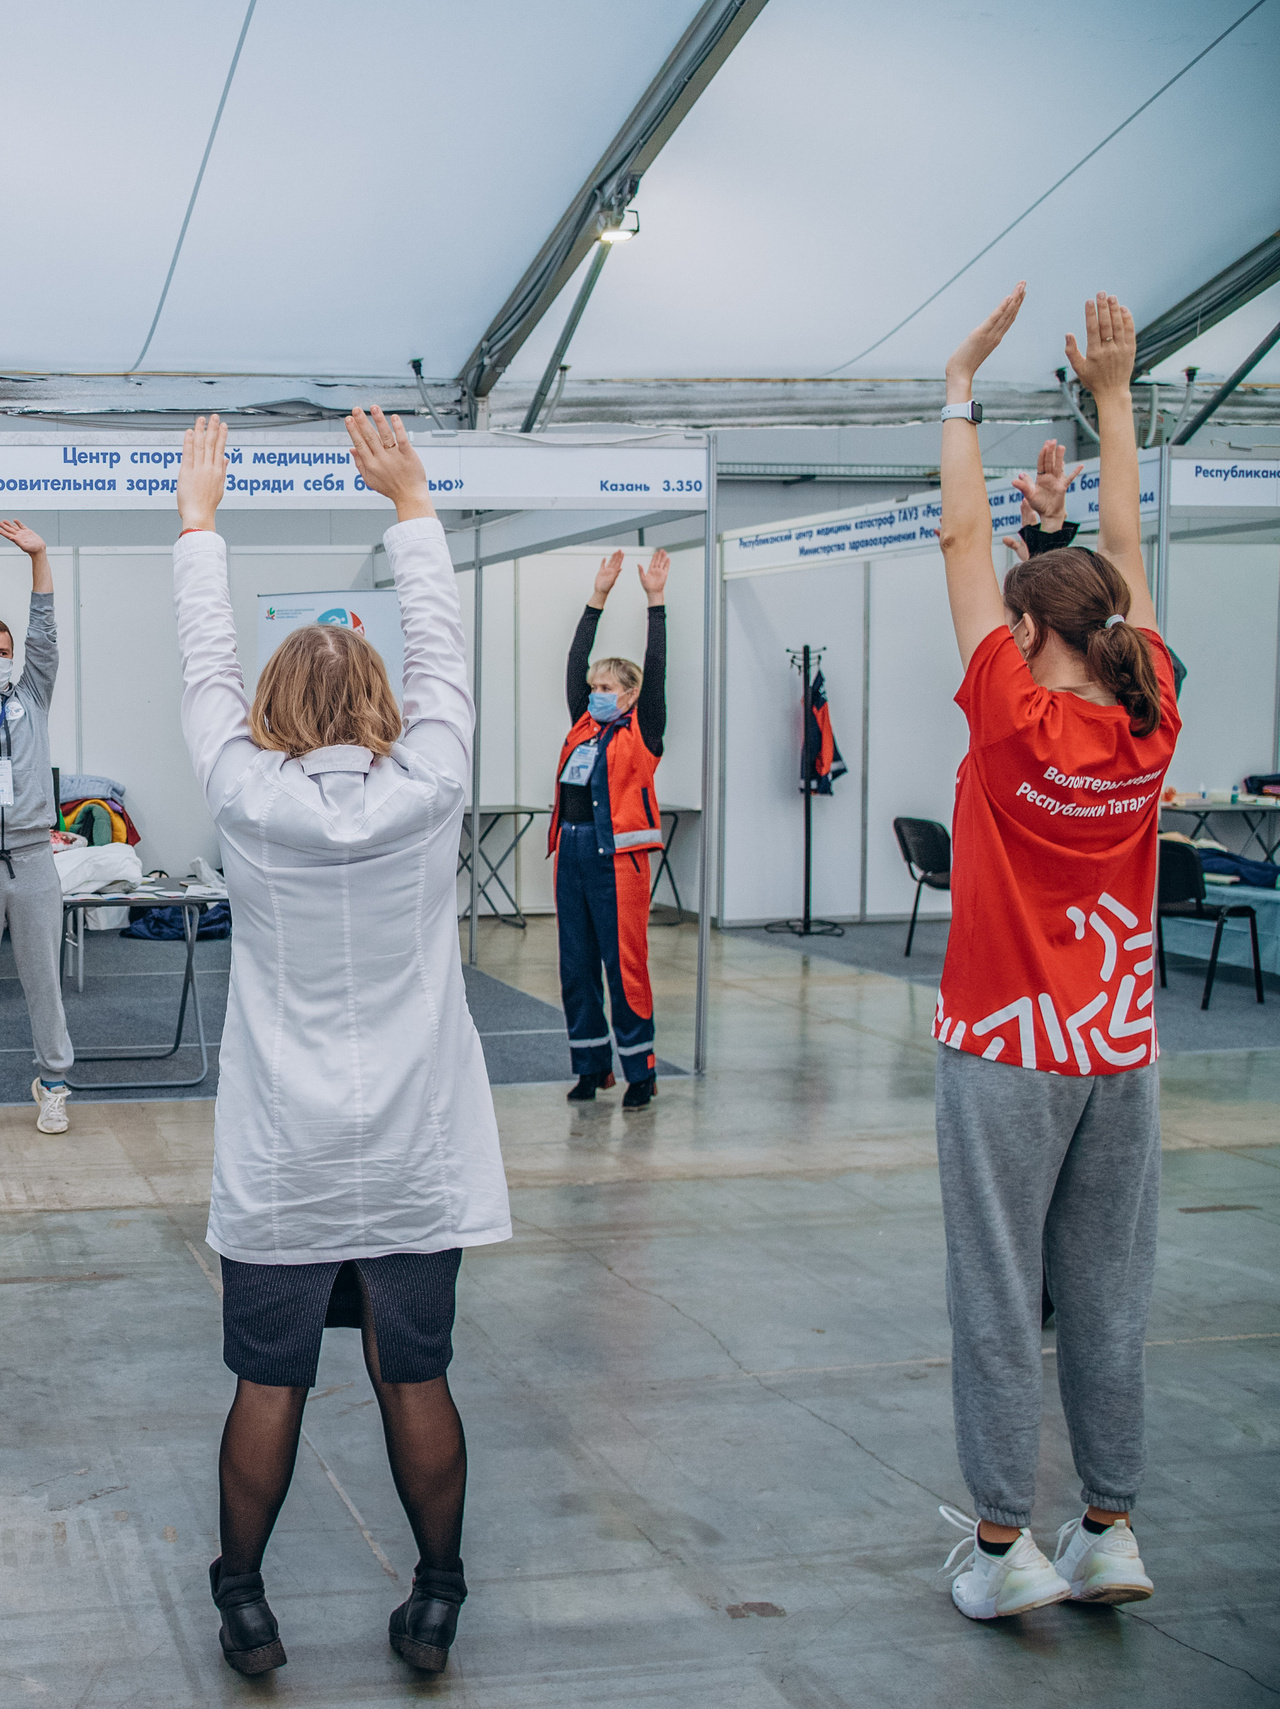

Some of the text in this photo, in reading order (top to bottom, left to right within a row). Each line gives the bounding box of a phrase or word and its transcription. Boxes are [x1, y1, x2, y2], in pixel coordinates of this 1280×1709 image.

[63, 447, 351, 469] Центр спортй медицины
[126, 478, 178, 496] заряд
[225, 474, 294, 496] Заряди
[303, 473, 345, 491] себя
[600, 480, 703, 492] Казань 3.350
[854, 512, 896, 529] катастроф
[898, 506, 919, 522] ГАУЗ
[1015, 781, 1159, 817] Республики Татар
